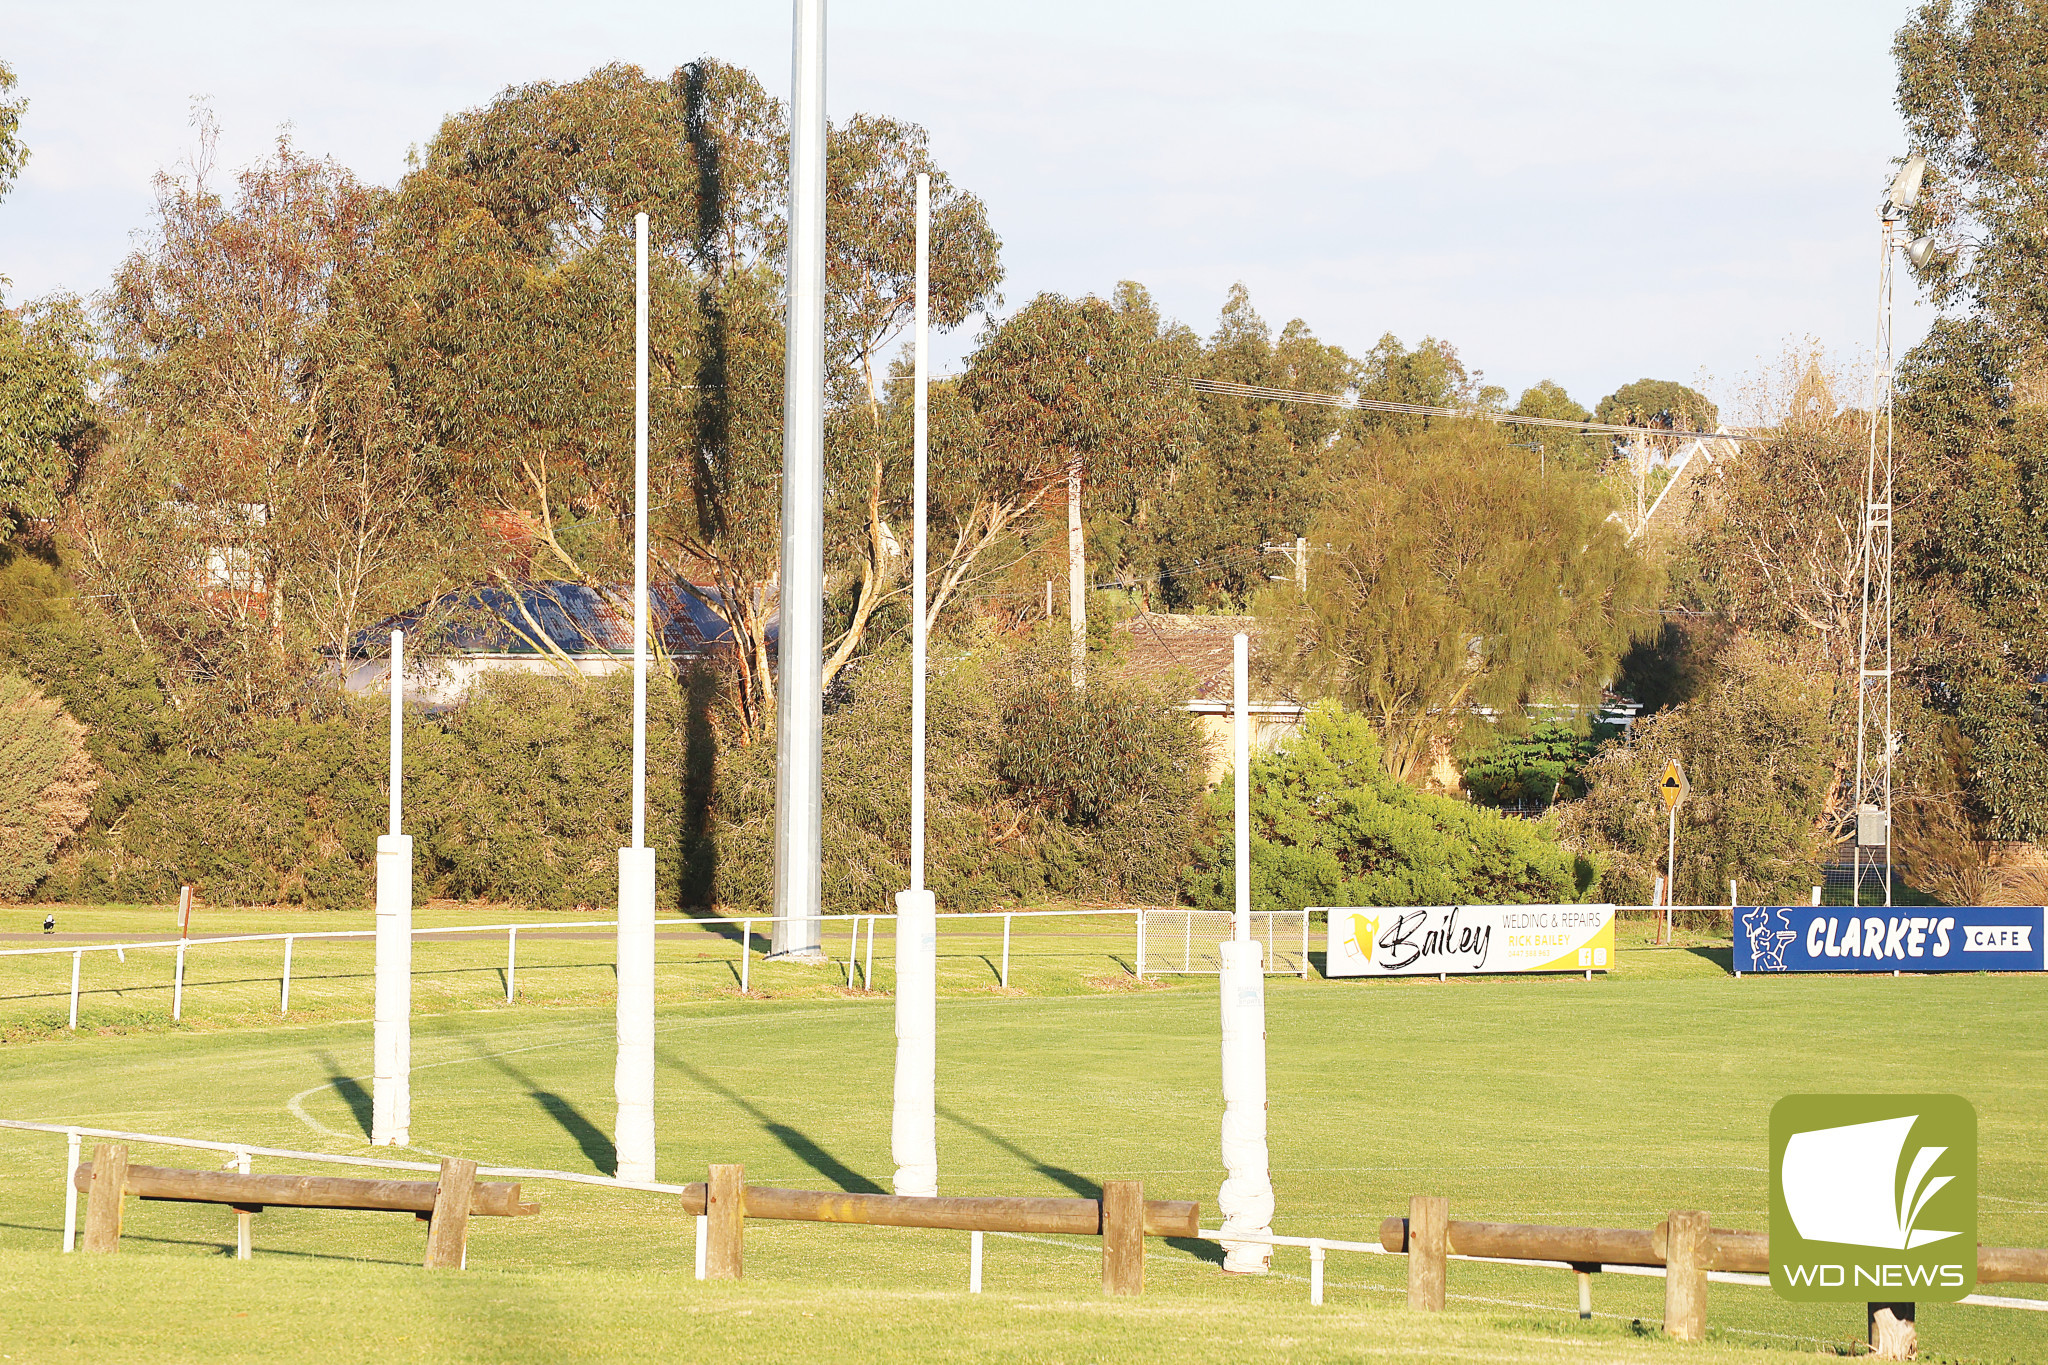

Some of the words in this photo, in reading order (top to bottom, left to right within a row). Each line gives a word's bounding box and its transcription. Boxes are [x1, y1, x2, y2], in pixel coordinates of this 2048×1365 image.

[1502, 913, 1548, 929] WELDING
[1551, 913, 1558, 928] &
[1561, 912, 1601, 928] REPAIRS
[1379, 906, 1491, 970] Bailey
[1508, 935, 1532, 947] RICK
[1534, 934, 1571, 946] BAILEY
[1806, 916, 1956, 961] CLARKE'S
[1974, 930, 2020, 946] CAFE
